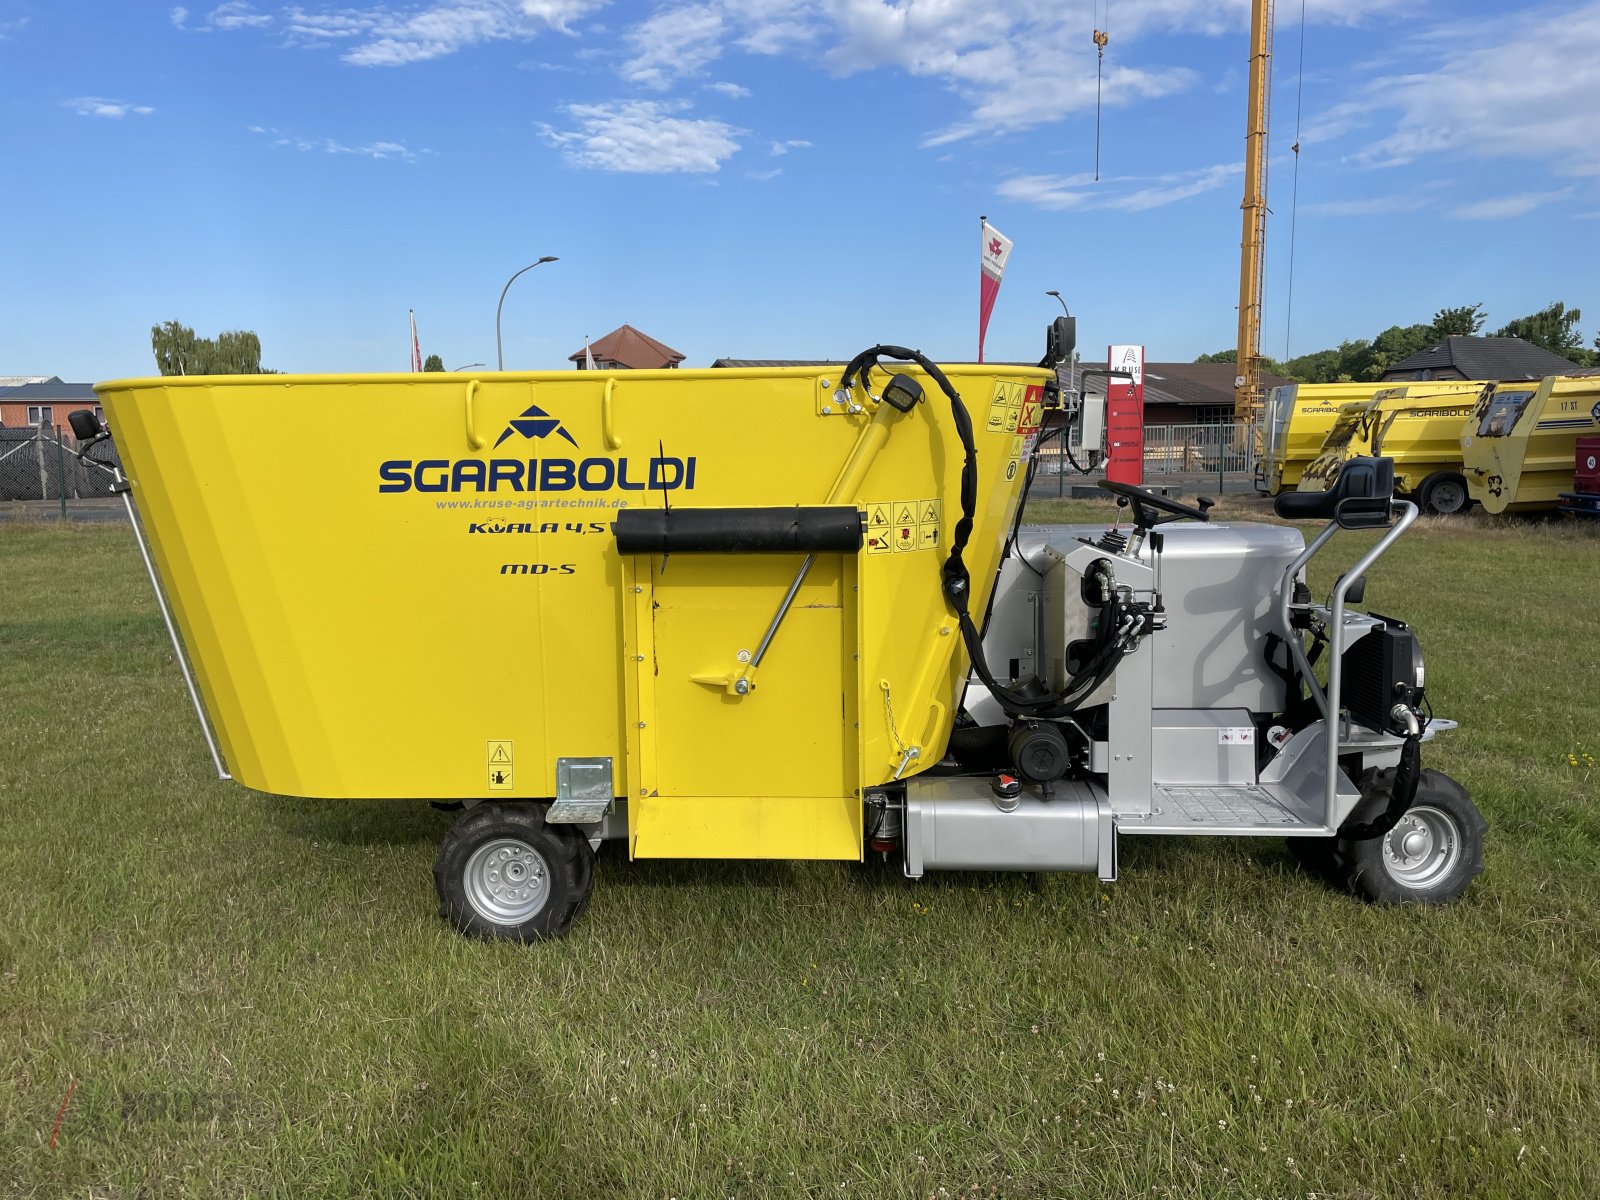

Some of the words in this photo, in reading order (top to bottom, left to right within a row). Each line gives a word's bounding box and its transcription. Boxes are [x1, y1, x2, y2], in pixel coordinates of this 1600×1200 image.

[1560, 401, 1568, 411] 17
[1570, 400, 1578, 410] ST
[1410, 409, 1472, 417] SGARIBOLD
[1589, 458, 1595, 467] 40
[378, 456, 697, 494] SGARIBOLDI
[435, 497, 628, 511] www.kruse-agrartechnik.de
[500, 563, 577, 575] MD-S
